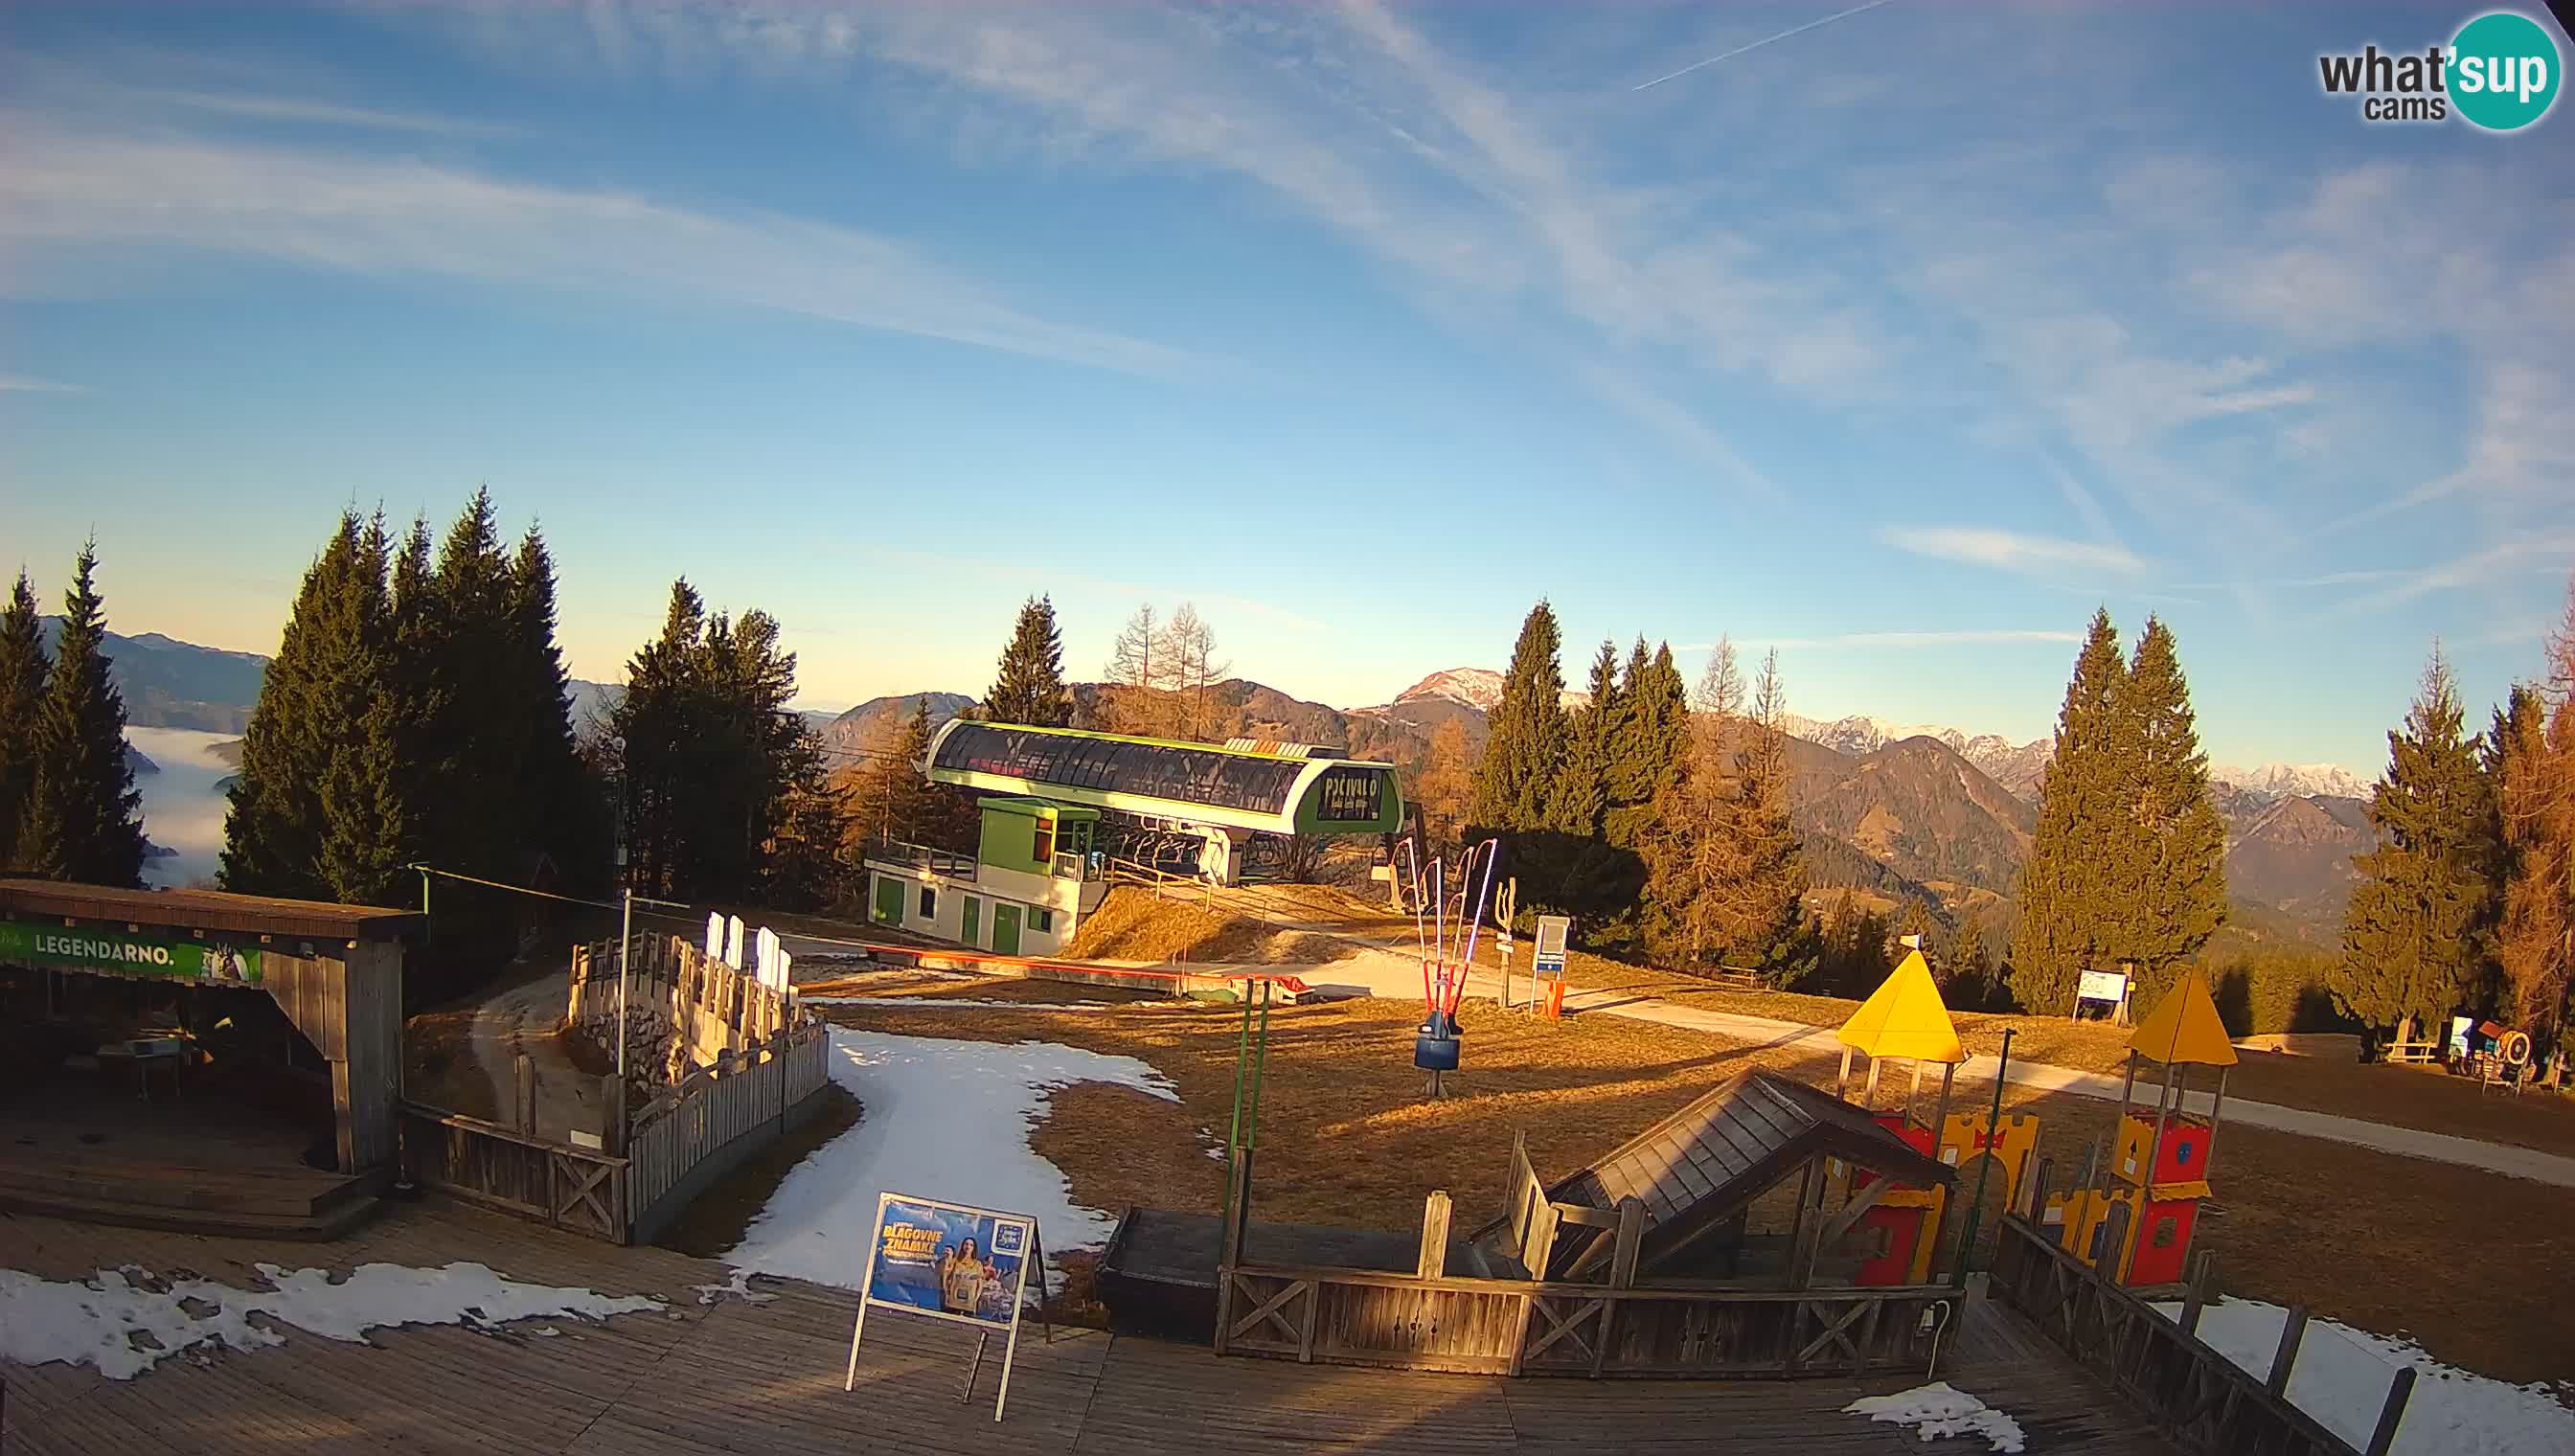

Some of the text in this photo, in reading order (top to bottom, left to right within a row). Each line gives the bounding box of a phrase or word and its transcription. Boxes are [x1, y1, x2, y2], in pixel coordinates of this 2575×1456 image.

[35, 934, 174, 966] LEGENDARNO.
[883, 1225, 944, 1242] BLAGOVNE
[887, 1238, 936, 1254] ZNAMKE
